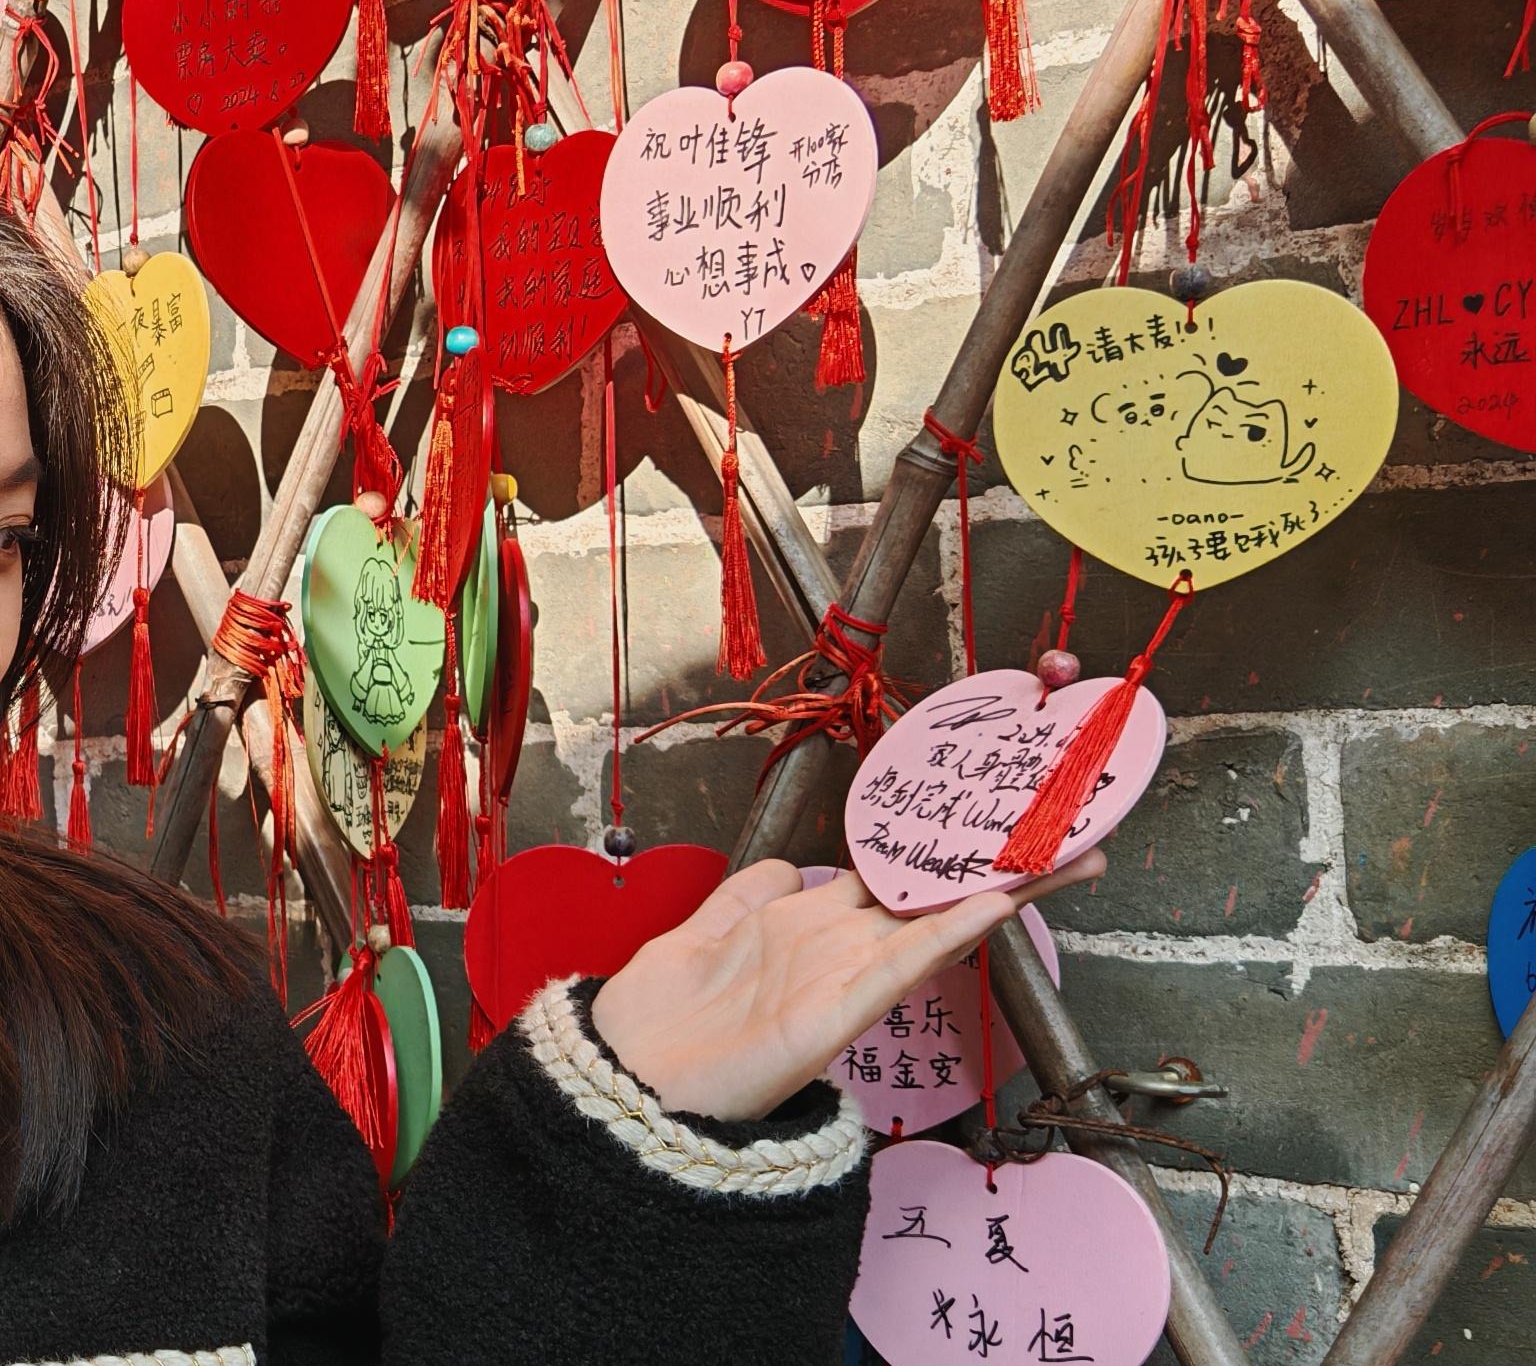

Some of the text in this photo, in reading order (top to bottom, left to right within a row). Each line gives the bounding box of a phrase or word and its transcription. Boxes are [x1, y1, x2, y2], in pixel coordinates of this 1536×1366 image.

[647, 183, 786, 242] 事业顺利
[664, 237, 790, 299] 心想事成
[1393, 294, 1454, 331] ZHL
[1460, 330, 1533, 370] 永远
